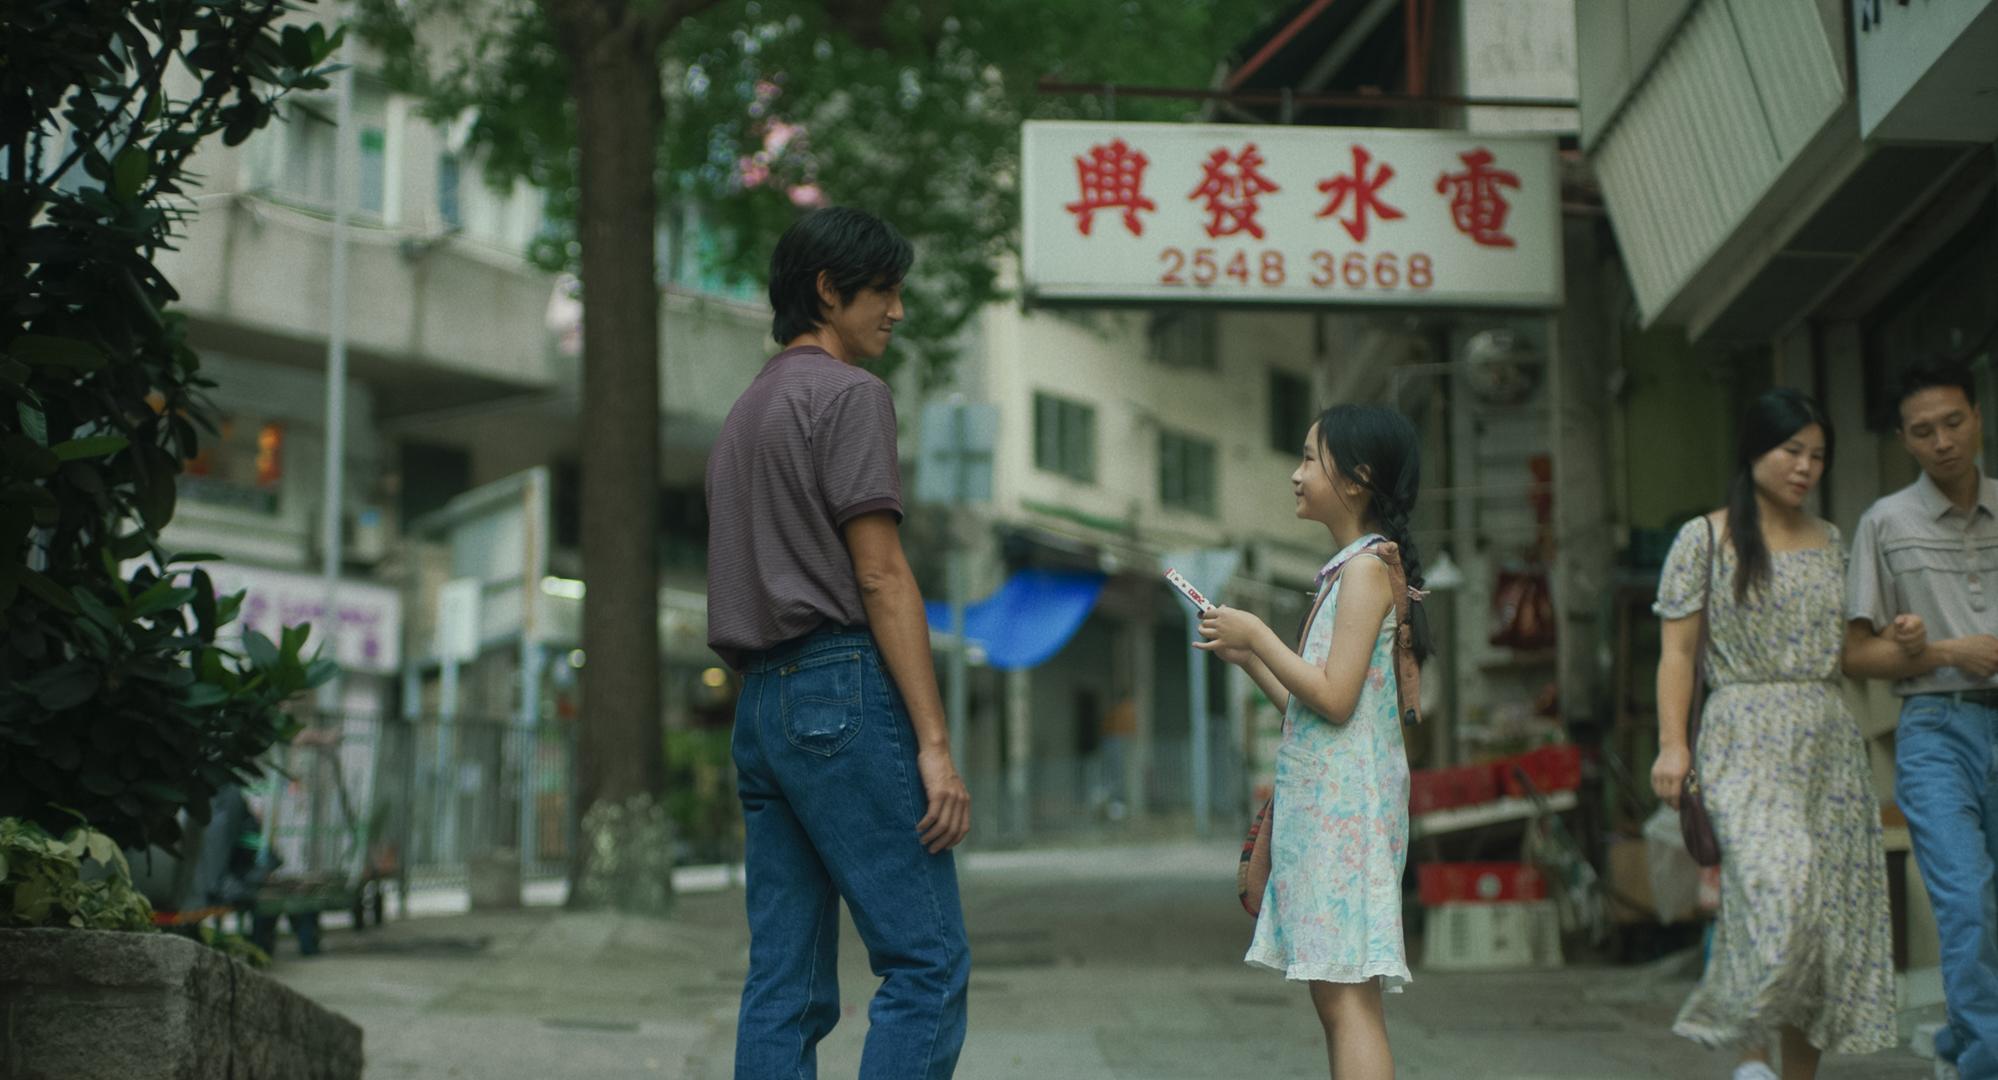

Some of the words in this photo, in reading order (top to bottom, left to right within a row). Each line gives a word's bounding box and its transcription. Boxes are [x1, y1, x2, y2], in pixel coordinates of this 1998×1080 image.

[1065, 138, 1521, 249] 興發水電
[1160, 249, 1285, 287] 2548
[1311, 253, 1434, 290] 3668
